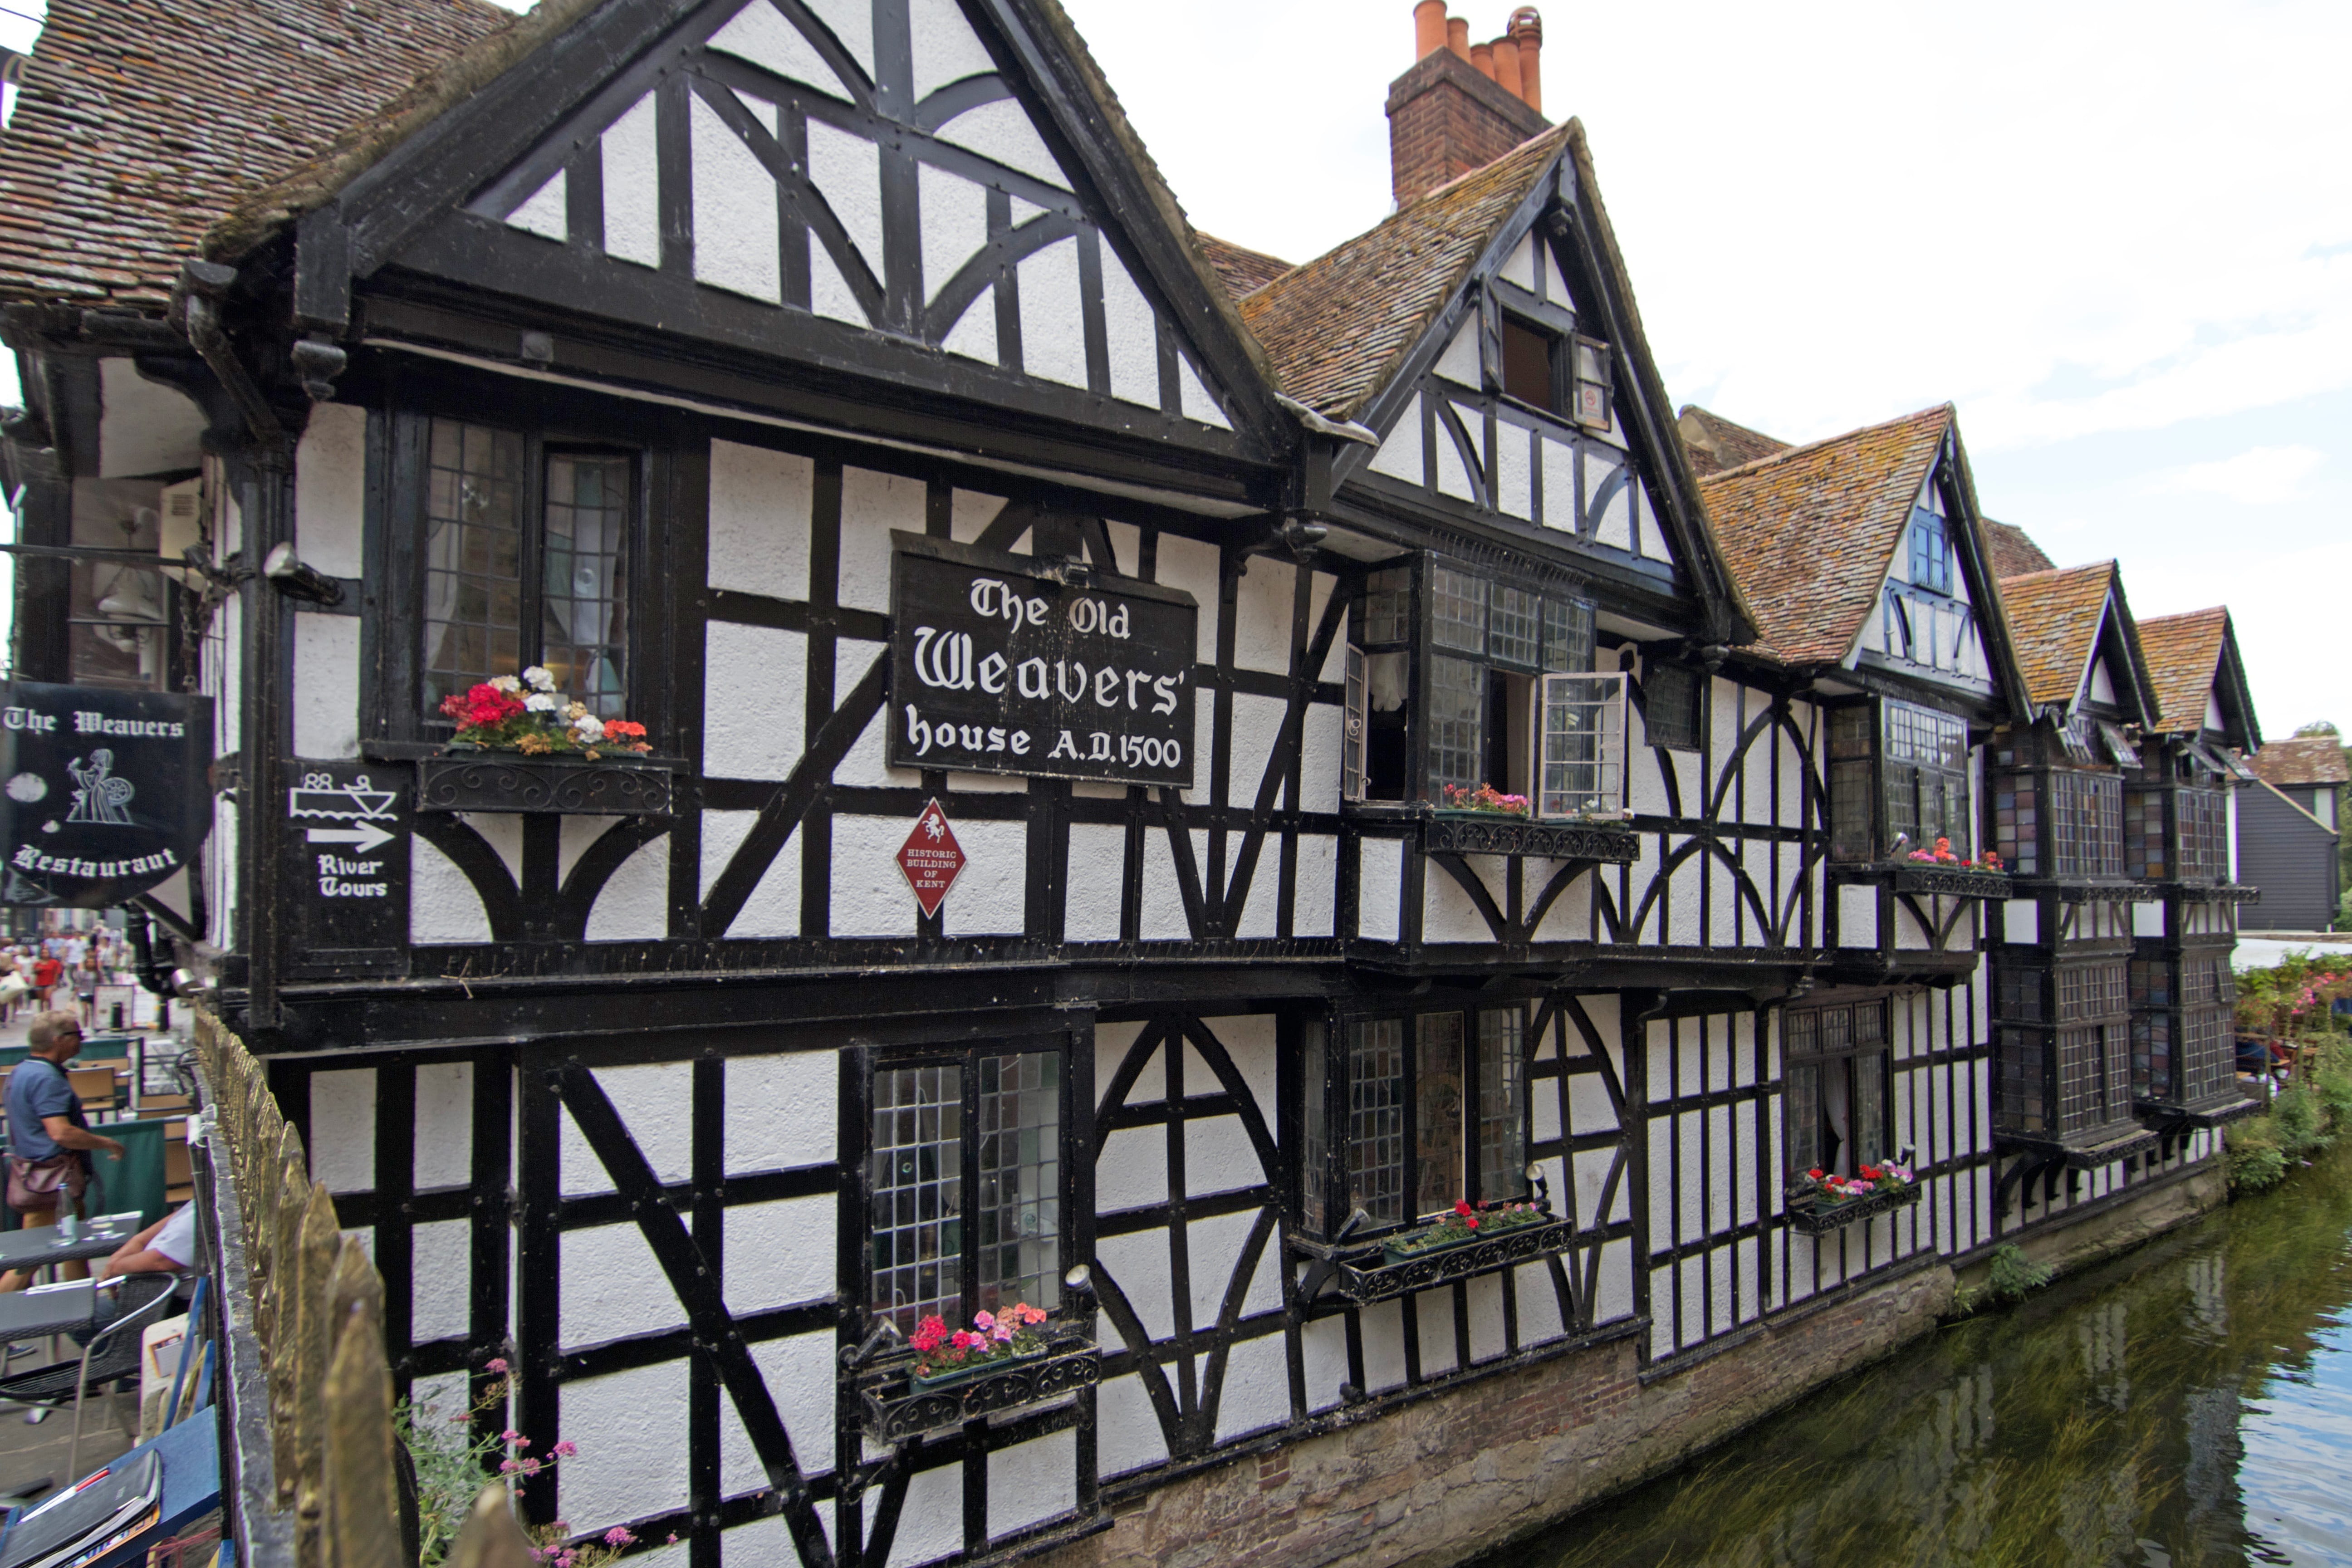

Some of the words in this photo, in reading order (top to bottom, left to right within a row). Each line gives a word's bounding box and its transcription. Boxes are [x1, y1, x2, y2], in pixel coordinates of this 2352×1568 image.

[970, 578, 1048, 633] The
[1069, 598, 1131, 639] Old
[914, 627, 1184, 715] Weavers'
[3, 706, 56, 735] The
[74, 711, 185, 737] Weavers
[906, 704, 1031, 756] house
[12, 844, 177, 877] Restaurant
[318, 854, 383, 875] River
[907, 849, 956, 858] HISTORIC
[907, 860, 956, 868] BUILDING
[318, 877, 387, 897] Tours
[916, 880, 946, 888] KENT
